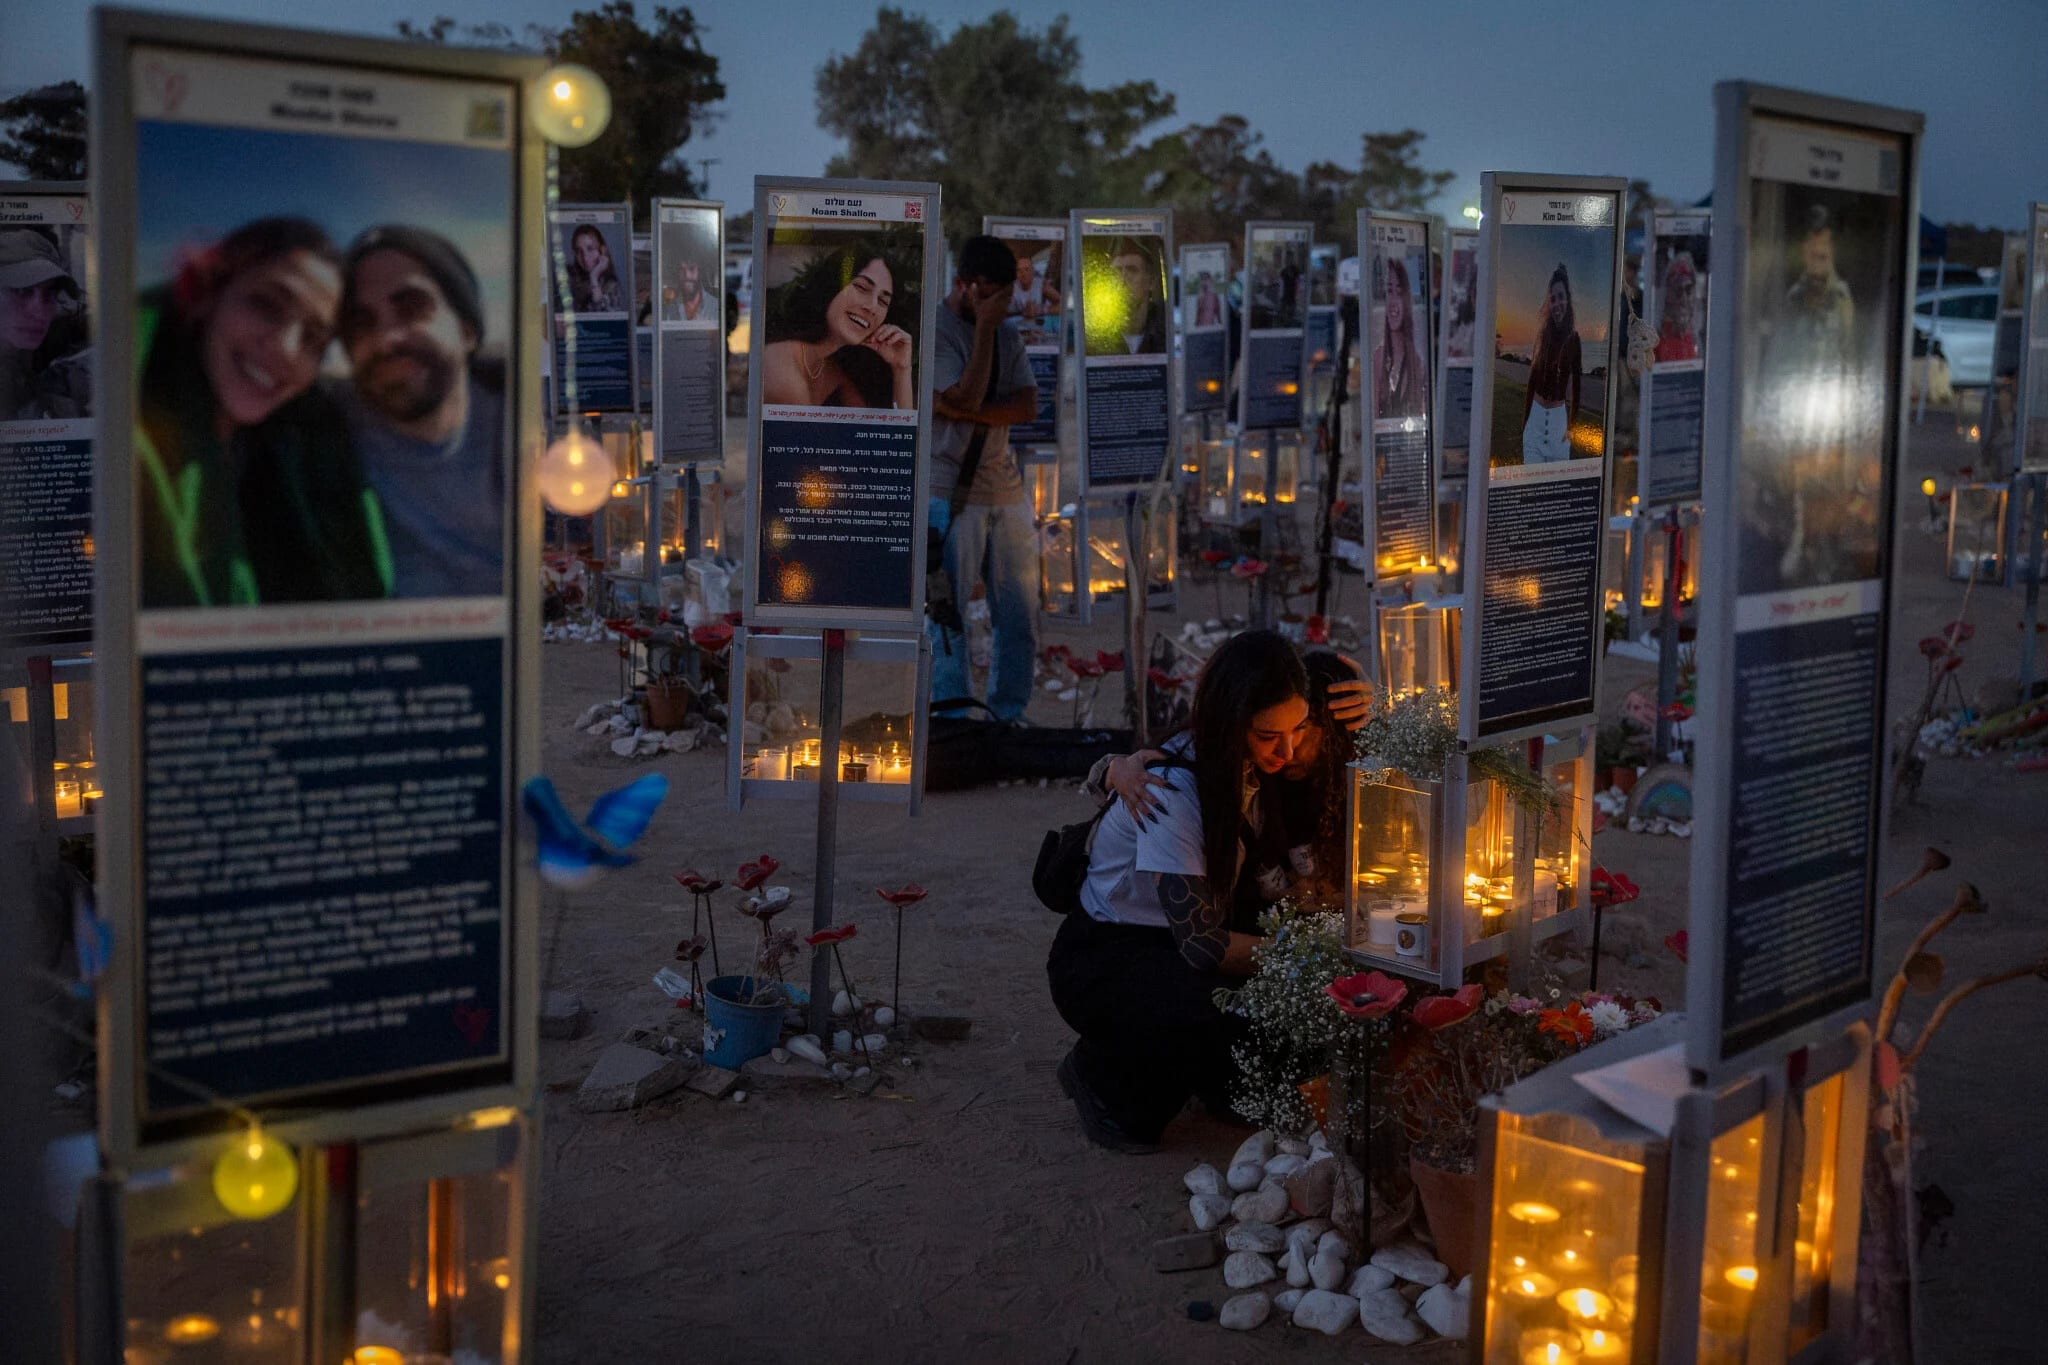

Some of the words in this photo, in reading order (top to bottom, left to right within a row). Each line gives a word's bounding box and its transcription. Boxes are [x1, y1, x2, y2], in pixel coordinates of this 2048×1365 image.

[824, 197, 845, 206] שלום
[812, 207, 838, 216] Noam
[840, 208, 877, 218] Shallom
[1542, 212, 1555, 221] Kim
